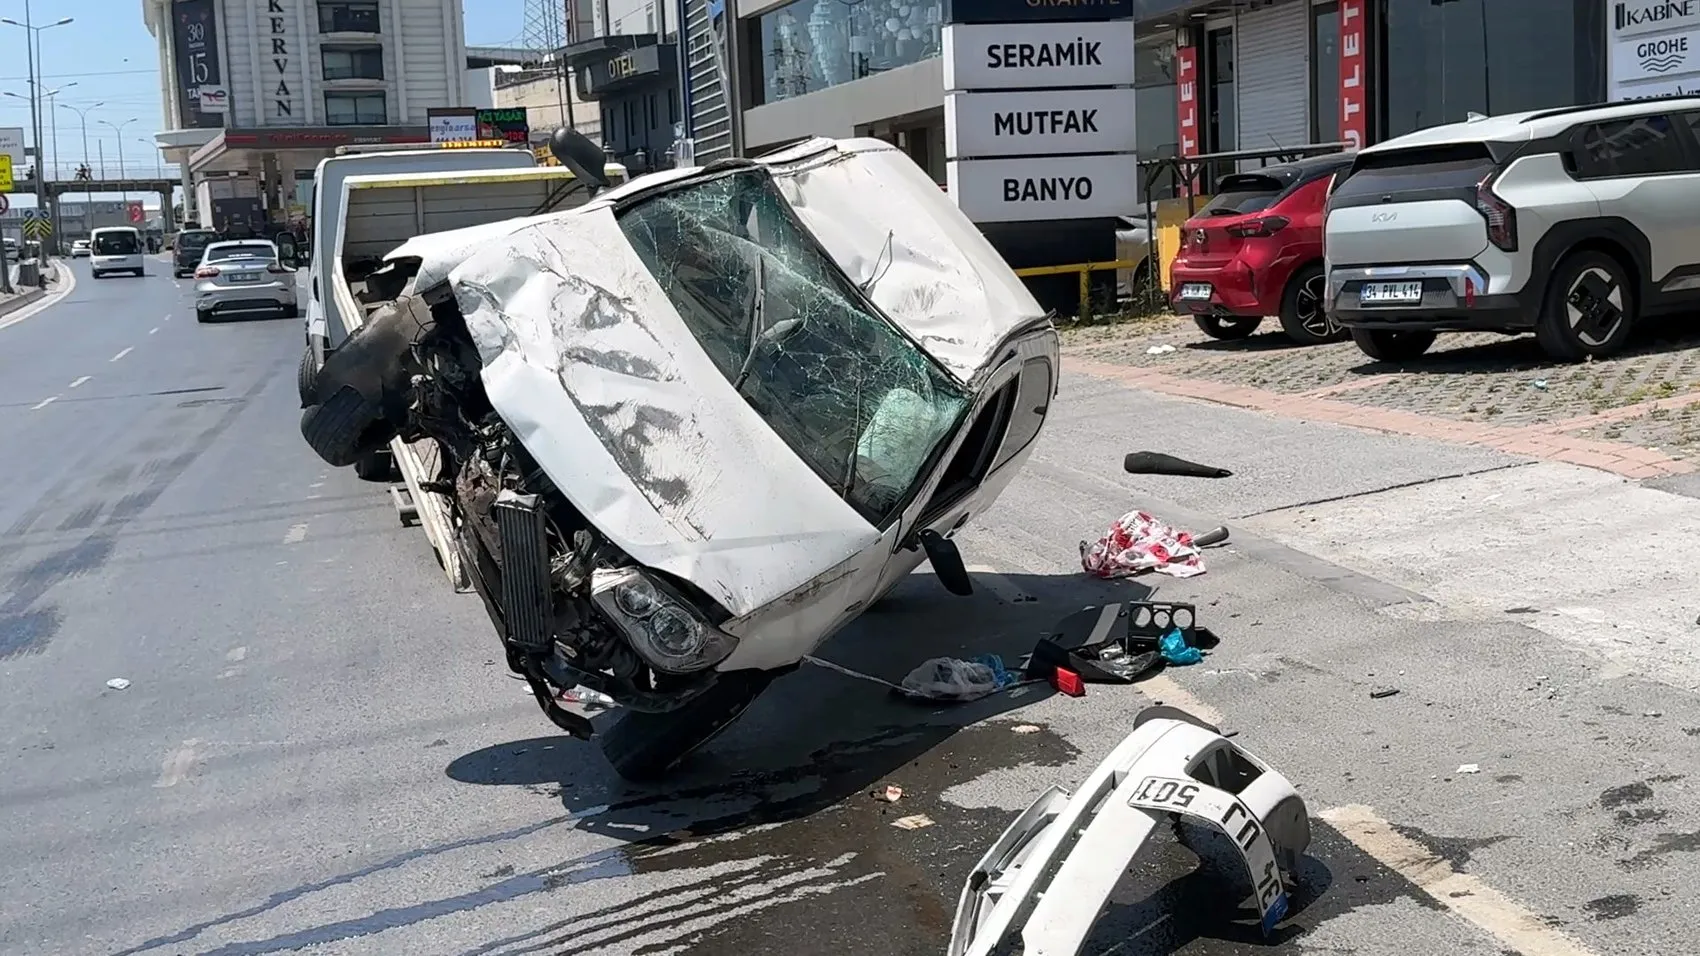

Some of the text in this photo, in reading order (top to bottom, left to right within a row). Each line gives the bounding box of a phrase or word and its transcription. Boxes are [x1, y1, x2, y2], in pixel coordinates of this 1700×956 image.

[187, 23, 205, 42] 30
[268, 0, 291, 117] KERVAN
[987, 37, 1102, 68] SERAMİK
[1637, 37, 1688, 58] GROHE
[189, 52, 209, 84] 15
[608, 54, 636, 79] OTEL
[1343, 2, 1361, 153] UTLET
[994, 109, 1098, 136] MUTFAK
[1003, 176, 1092, 202] BANYO
[1366, 285, 1377, 299] 34
[1402, 283, 1419, 298] 414
[1137, 779, 1280, 910] 34 UJ 501
